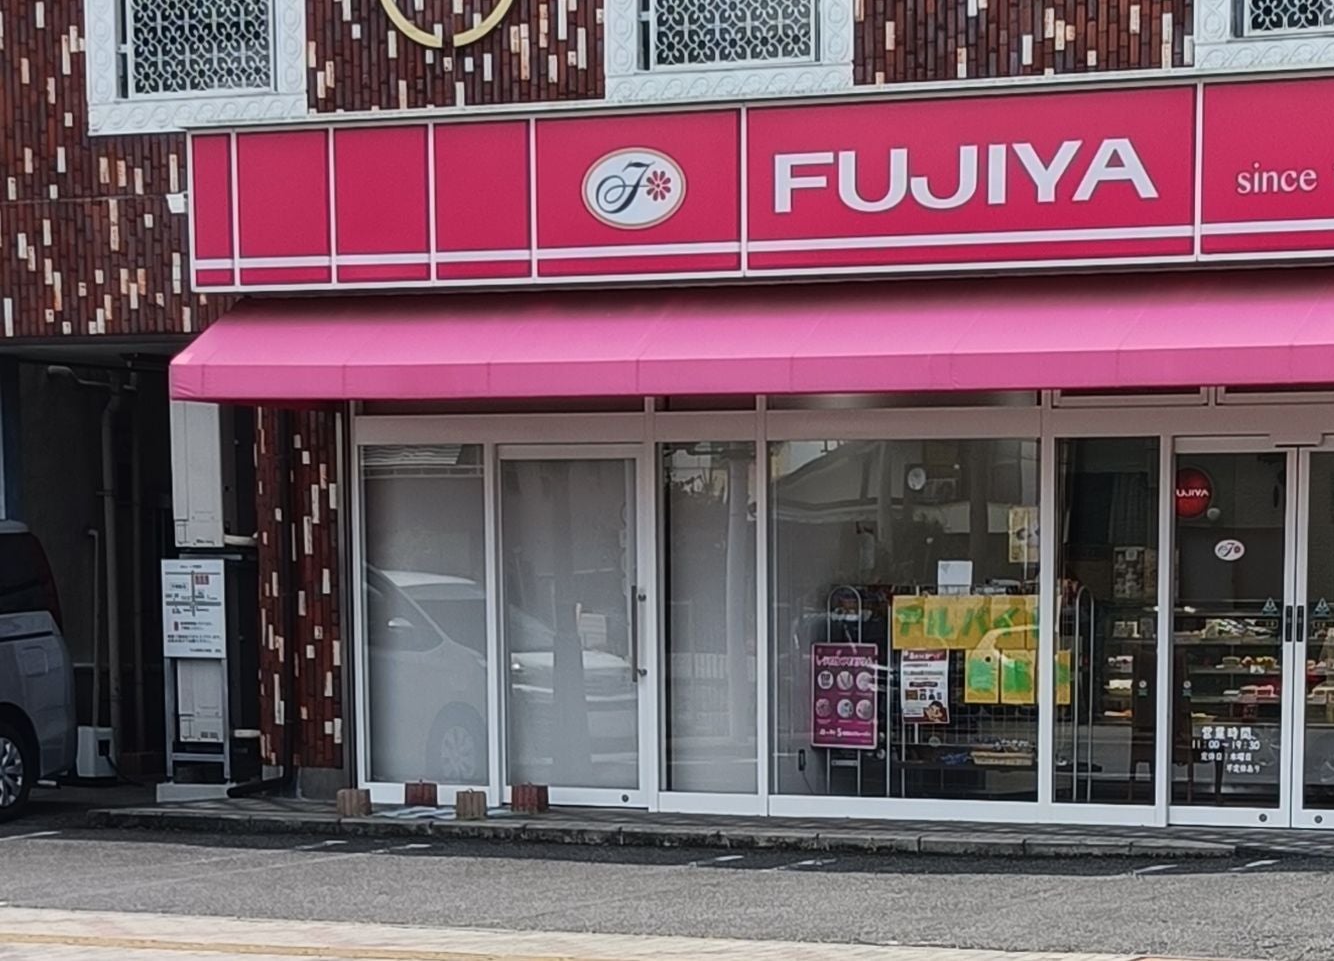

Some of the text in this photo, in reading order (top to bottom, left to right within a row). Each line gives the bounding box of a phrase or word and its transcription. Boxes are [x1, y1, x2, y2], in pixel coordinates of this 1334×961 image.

[774, 138, 1159, 213] FUJIYA
[1237, 162, 1318, 194] since
[1176, 488, 1209, 498] UJIYA
